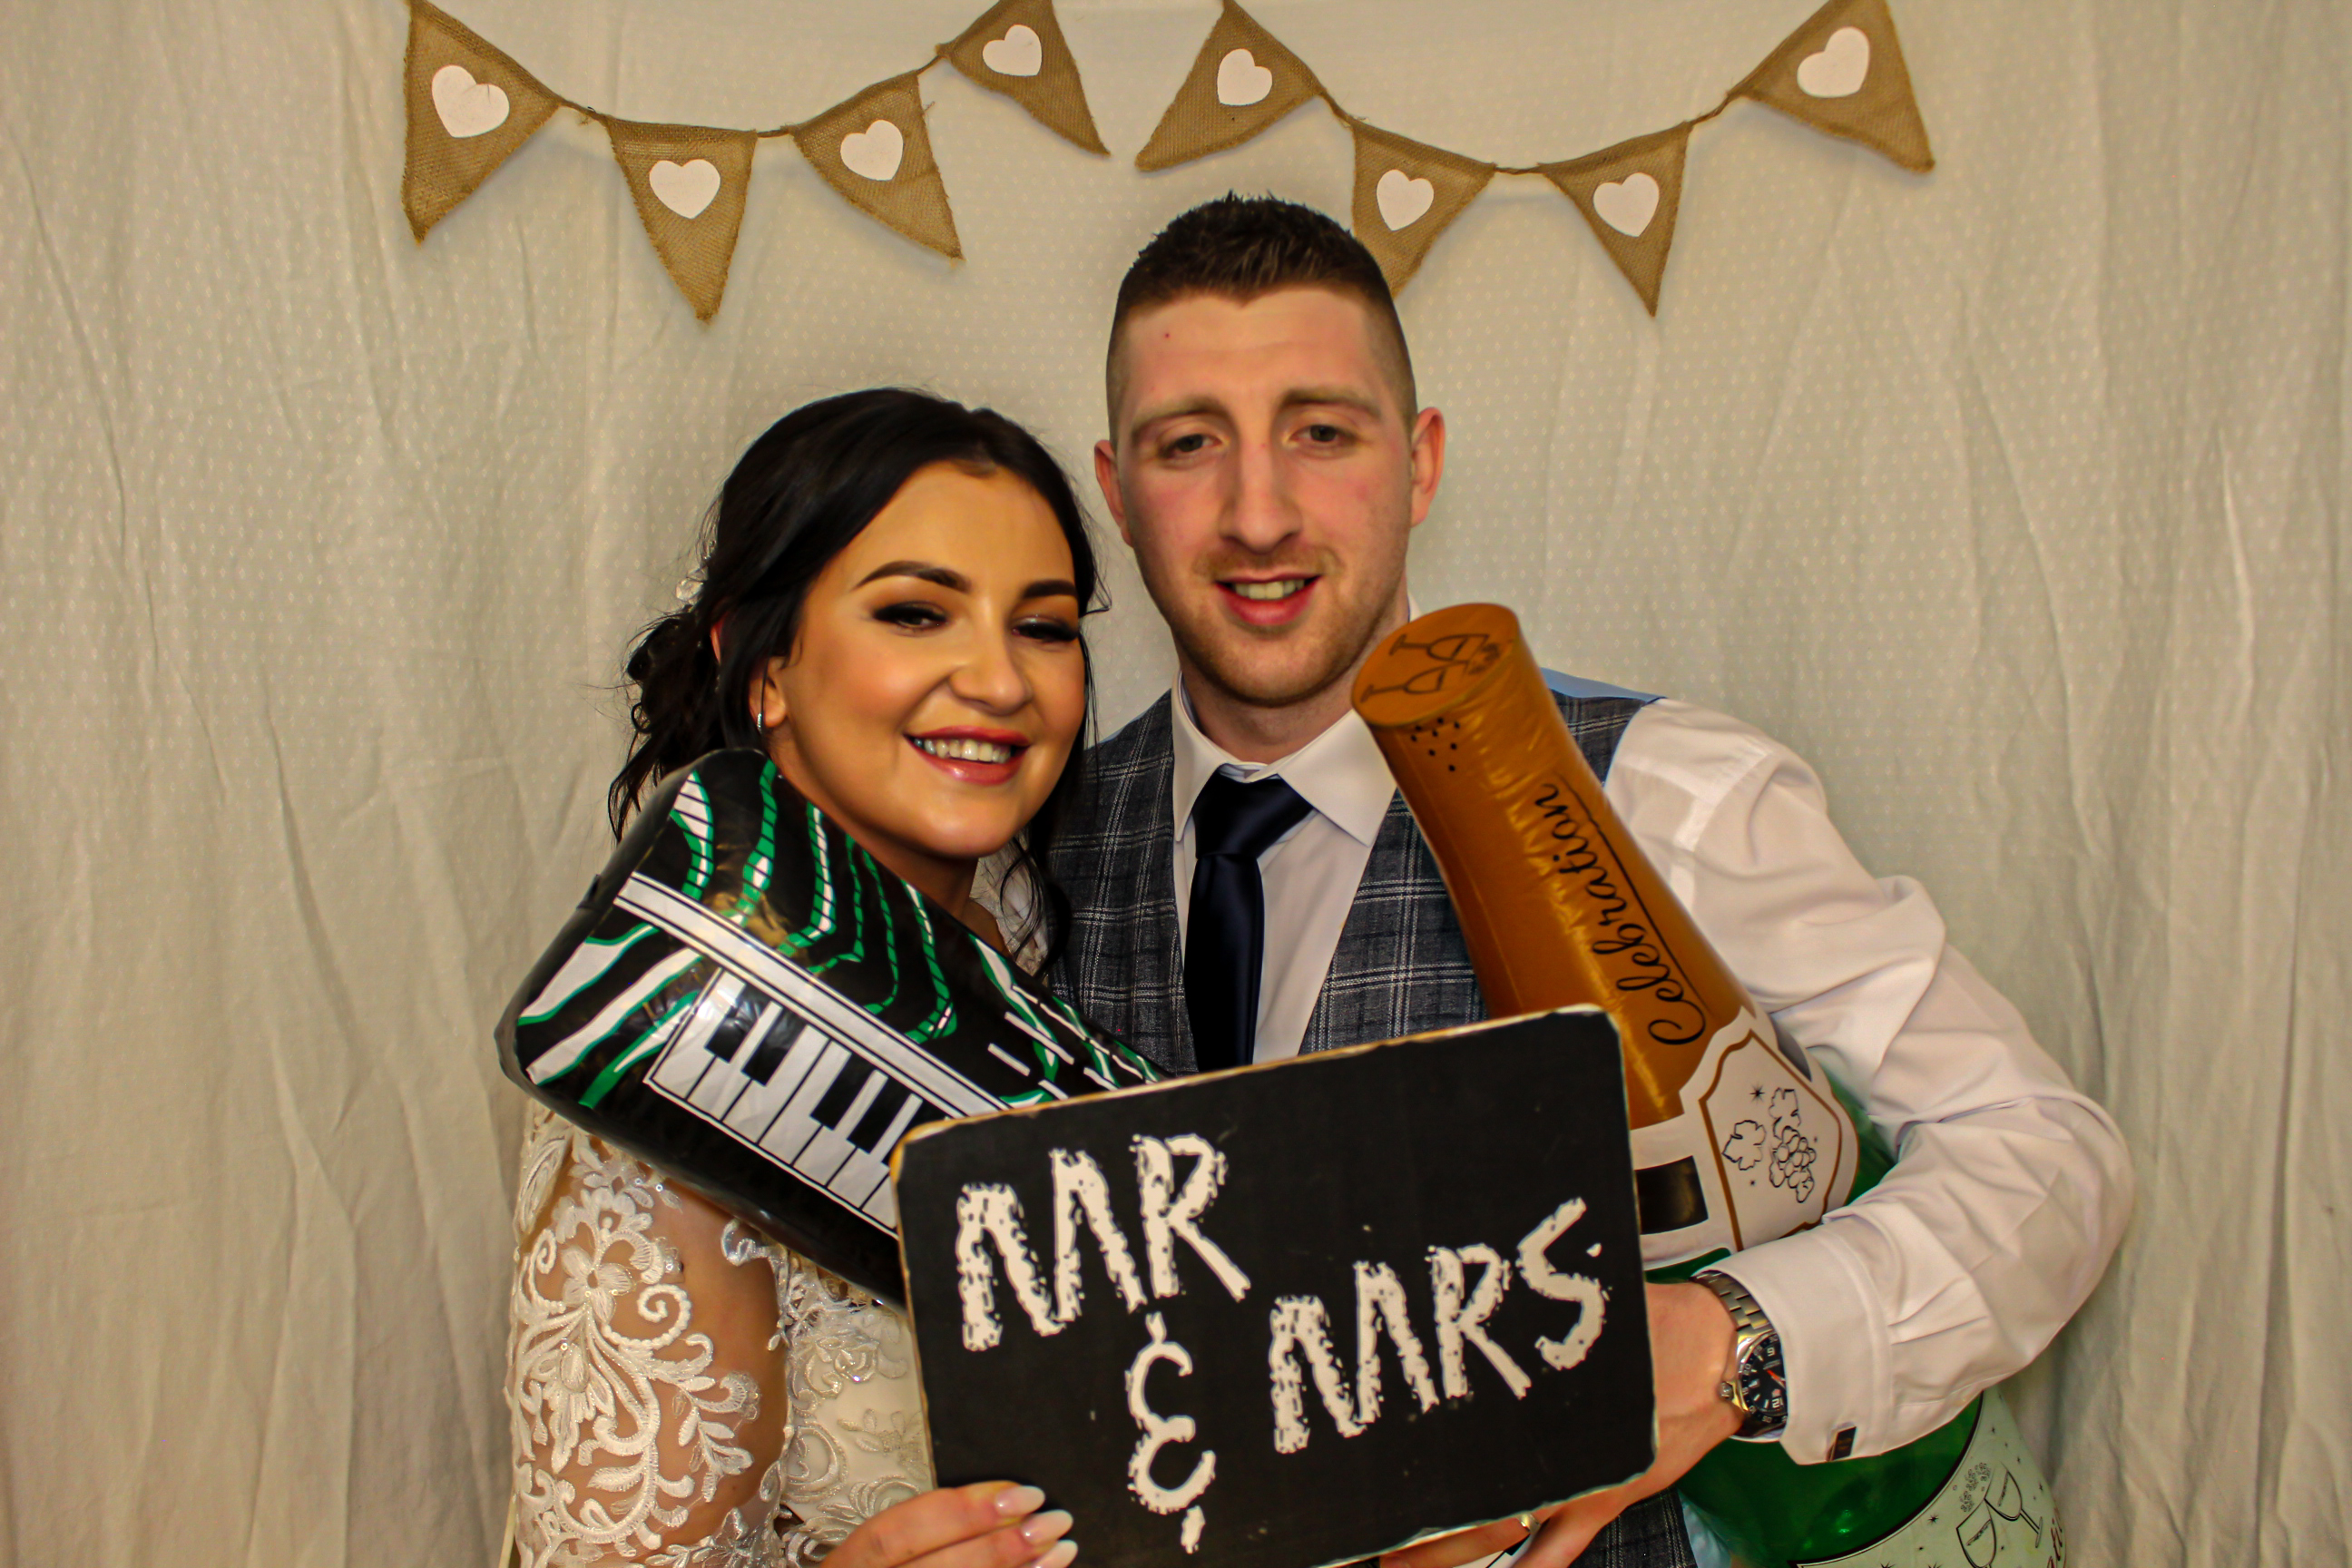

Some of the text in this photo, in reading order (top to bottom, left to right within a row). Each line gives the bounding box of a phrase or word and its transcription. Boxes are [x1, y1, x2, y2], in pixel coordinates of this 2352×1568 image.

[1534, 783, 1706, 1044] Celebration
[956, 1132, 1251, 1352] MR
[1125, 1198, 1612, 1553] & MRS
